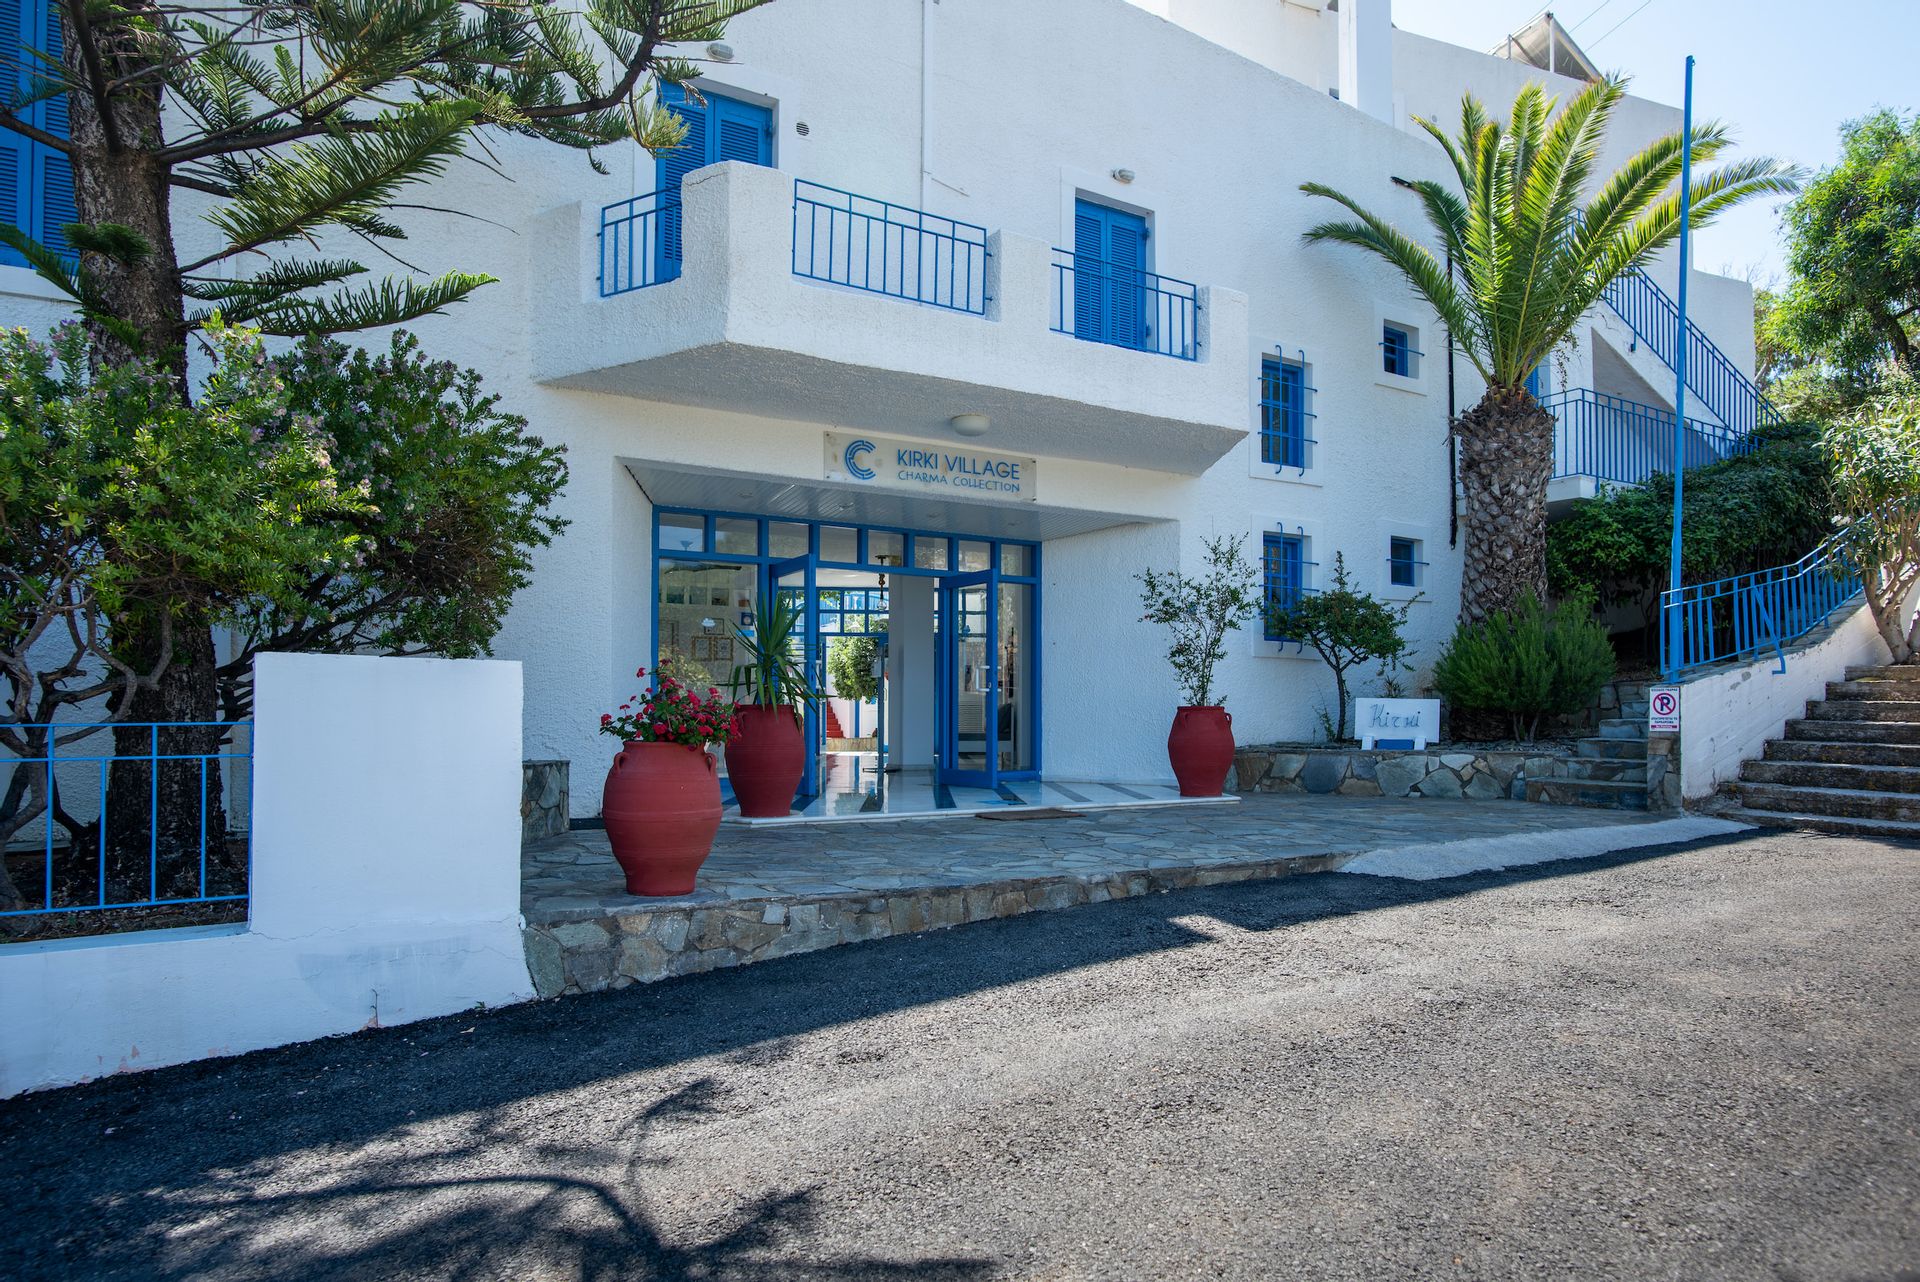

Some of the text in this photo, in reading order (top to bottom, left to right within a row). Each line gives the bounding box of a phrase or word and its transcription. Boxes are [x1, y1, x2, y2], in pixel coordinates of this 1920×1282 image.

[897, 448, 1020, 480] KIRKI VILLAGE
[897, 470, 1020, 493] CHARMA COLLECTION
